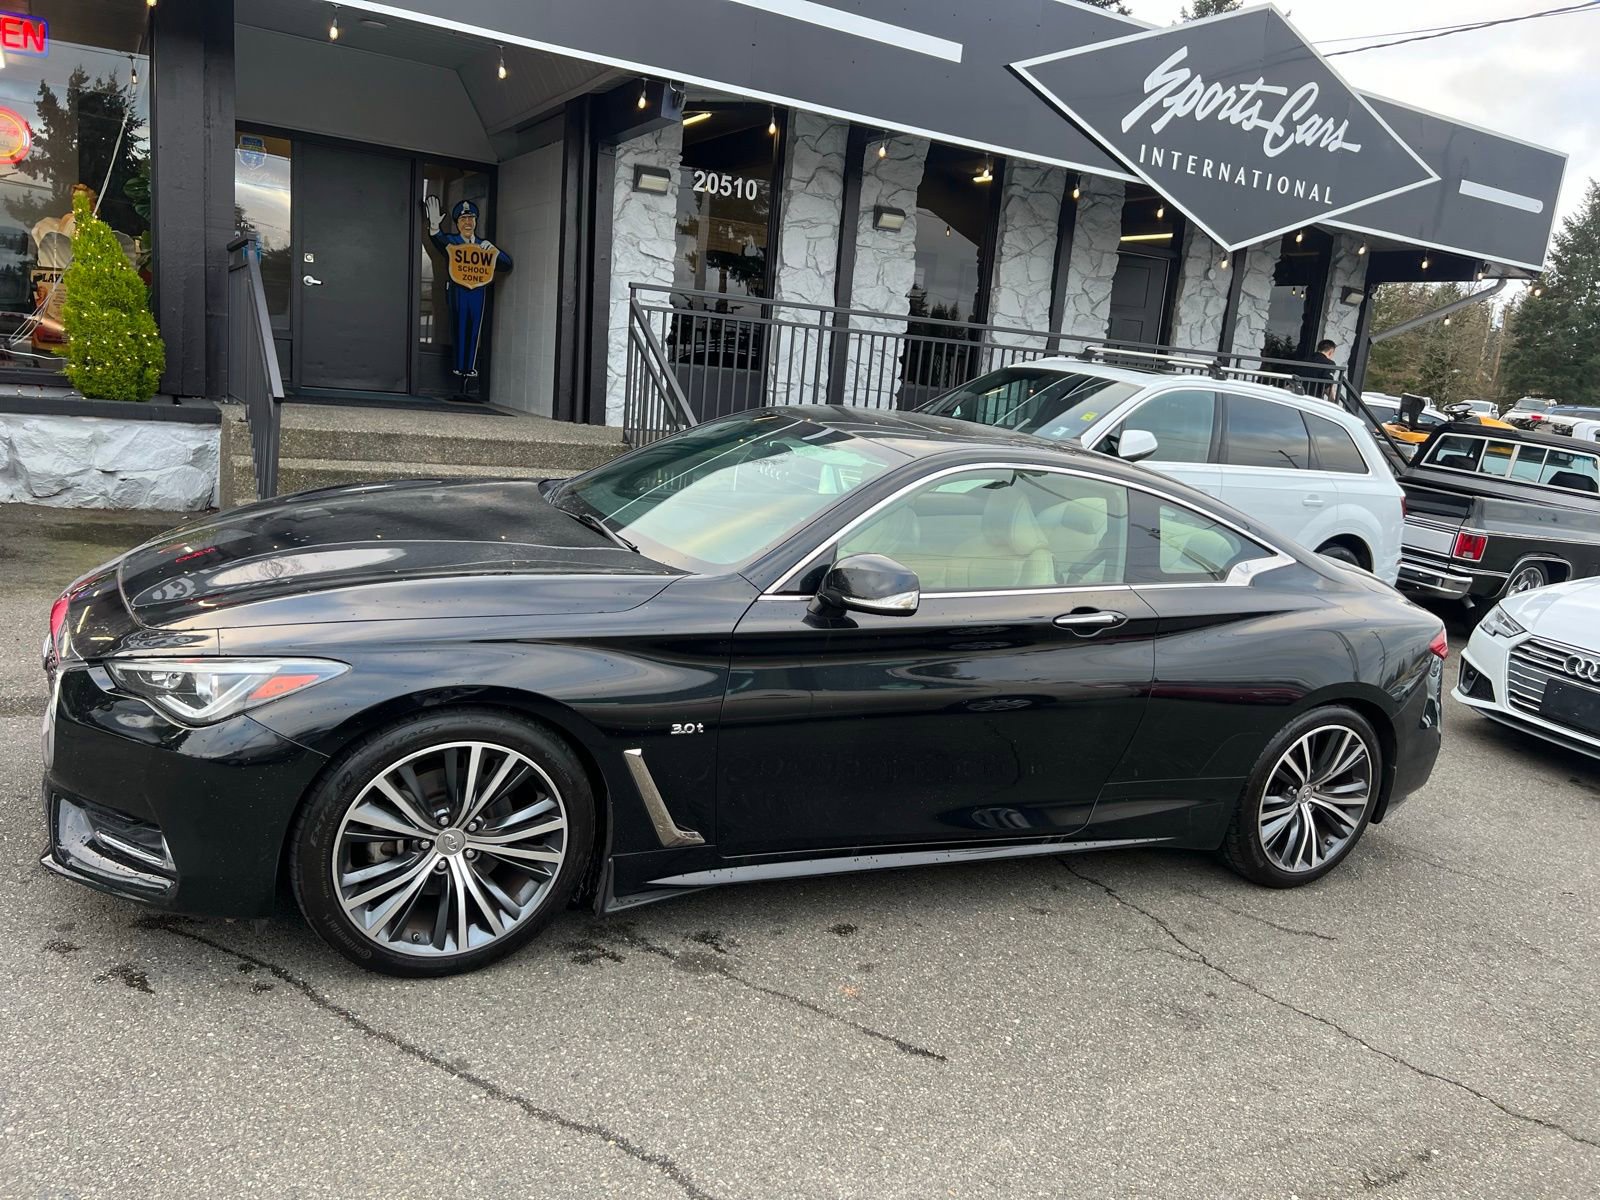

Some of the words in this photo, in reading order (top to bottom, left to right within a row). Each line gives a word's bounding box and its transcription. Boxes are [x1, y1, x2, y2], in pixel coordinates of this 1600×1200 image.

[1121, 45, 1289, 135] Sports
[1263, 81, 1362, 158] Cars
[692, 170, 758, 201] 20510
[1139, 144, 1333, 205] INTERNATIONAL
[455, 250, 493, 266] SLOW
[457, 264, 489, 275] SCHOOL
[462, 274, 484, 283] ZONE
